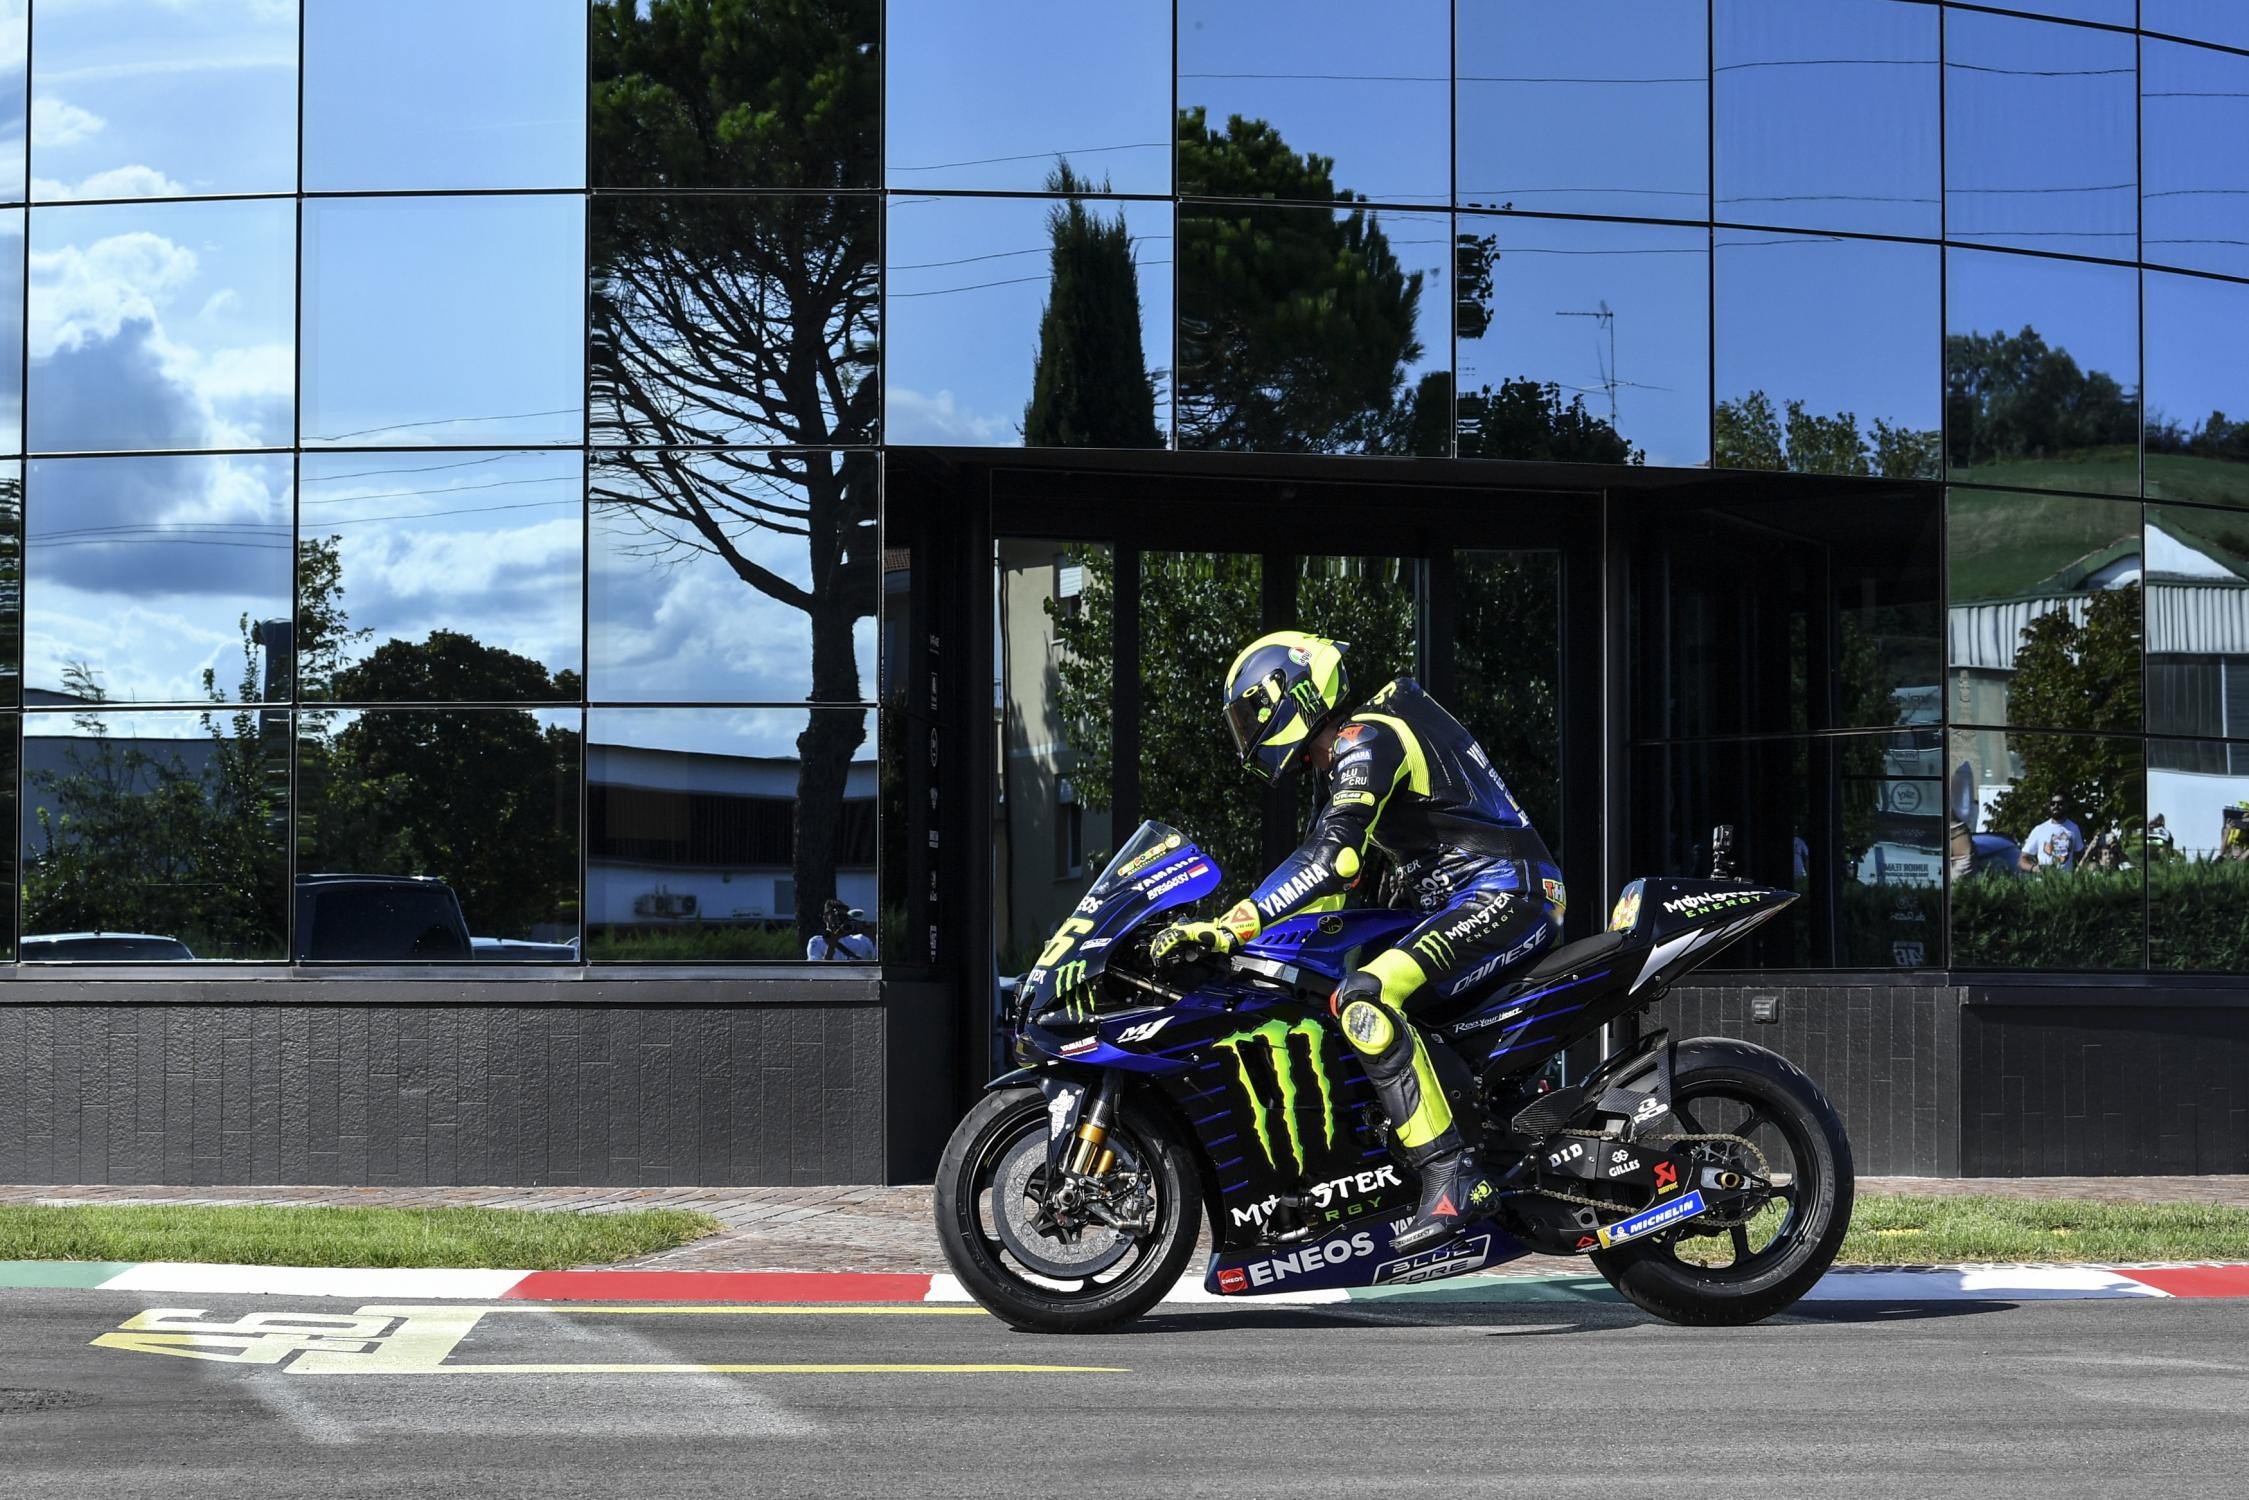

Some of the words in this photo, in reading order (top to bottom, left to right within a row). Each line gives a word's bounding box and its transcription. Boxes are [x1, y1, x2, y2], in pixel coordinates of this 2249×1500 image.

[1131, 856, 1200, 892] YAMAHA
[1258, 862, 1330, 918] YAMAHA
[1445, 891, 1515, 940] MONSTER
[1663, 890, 1771, 914] MONSTER
[1684, 896, 1762, 918] ENERGY
[1466, 907, 1515, 943] ENERGY
[1451, 923, 1547, 996] DAINESE
[1608, 1159, 1640, 1177] GILLES
[1231, 1164, 1402, 1227] MOSTER
[1630, 1200, 1694, 1234] MICHELIN
[1248, 1231, 1375, 1287] ENEOS
[1221, 1275, 1245, 1285] ENEOS
